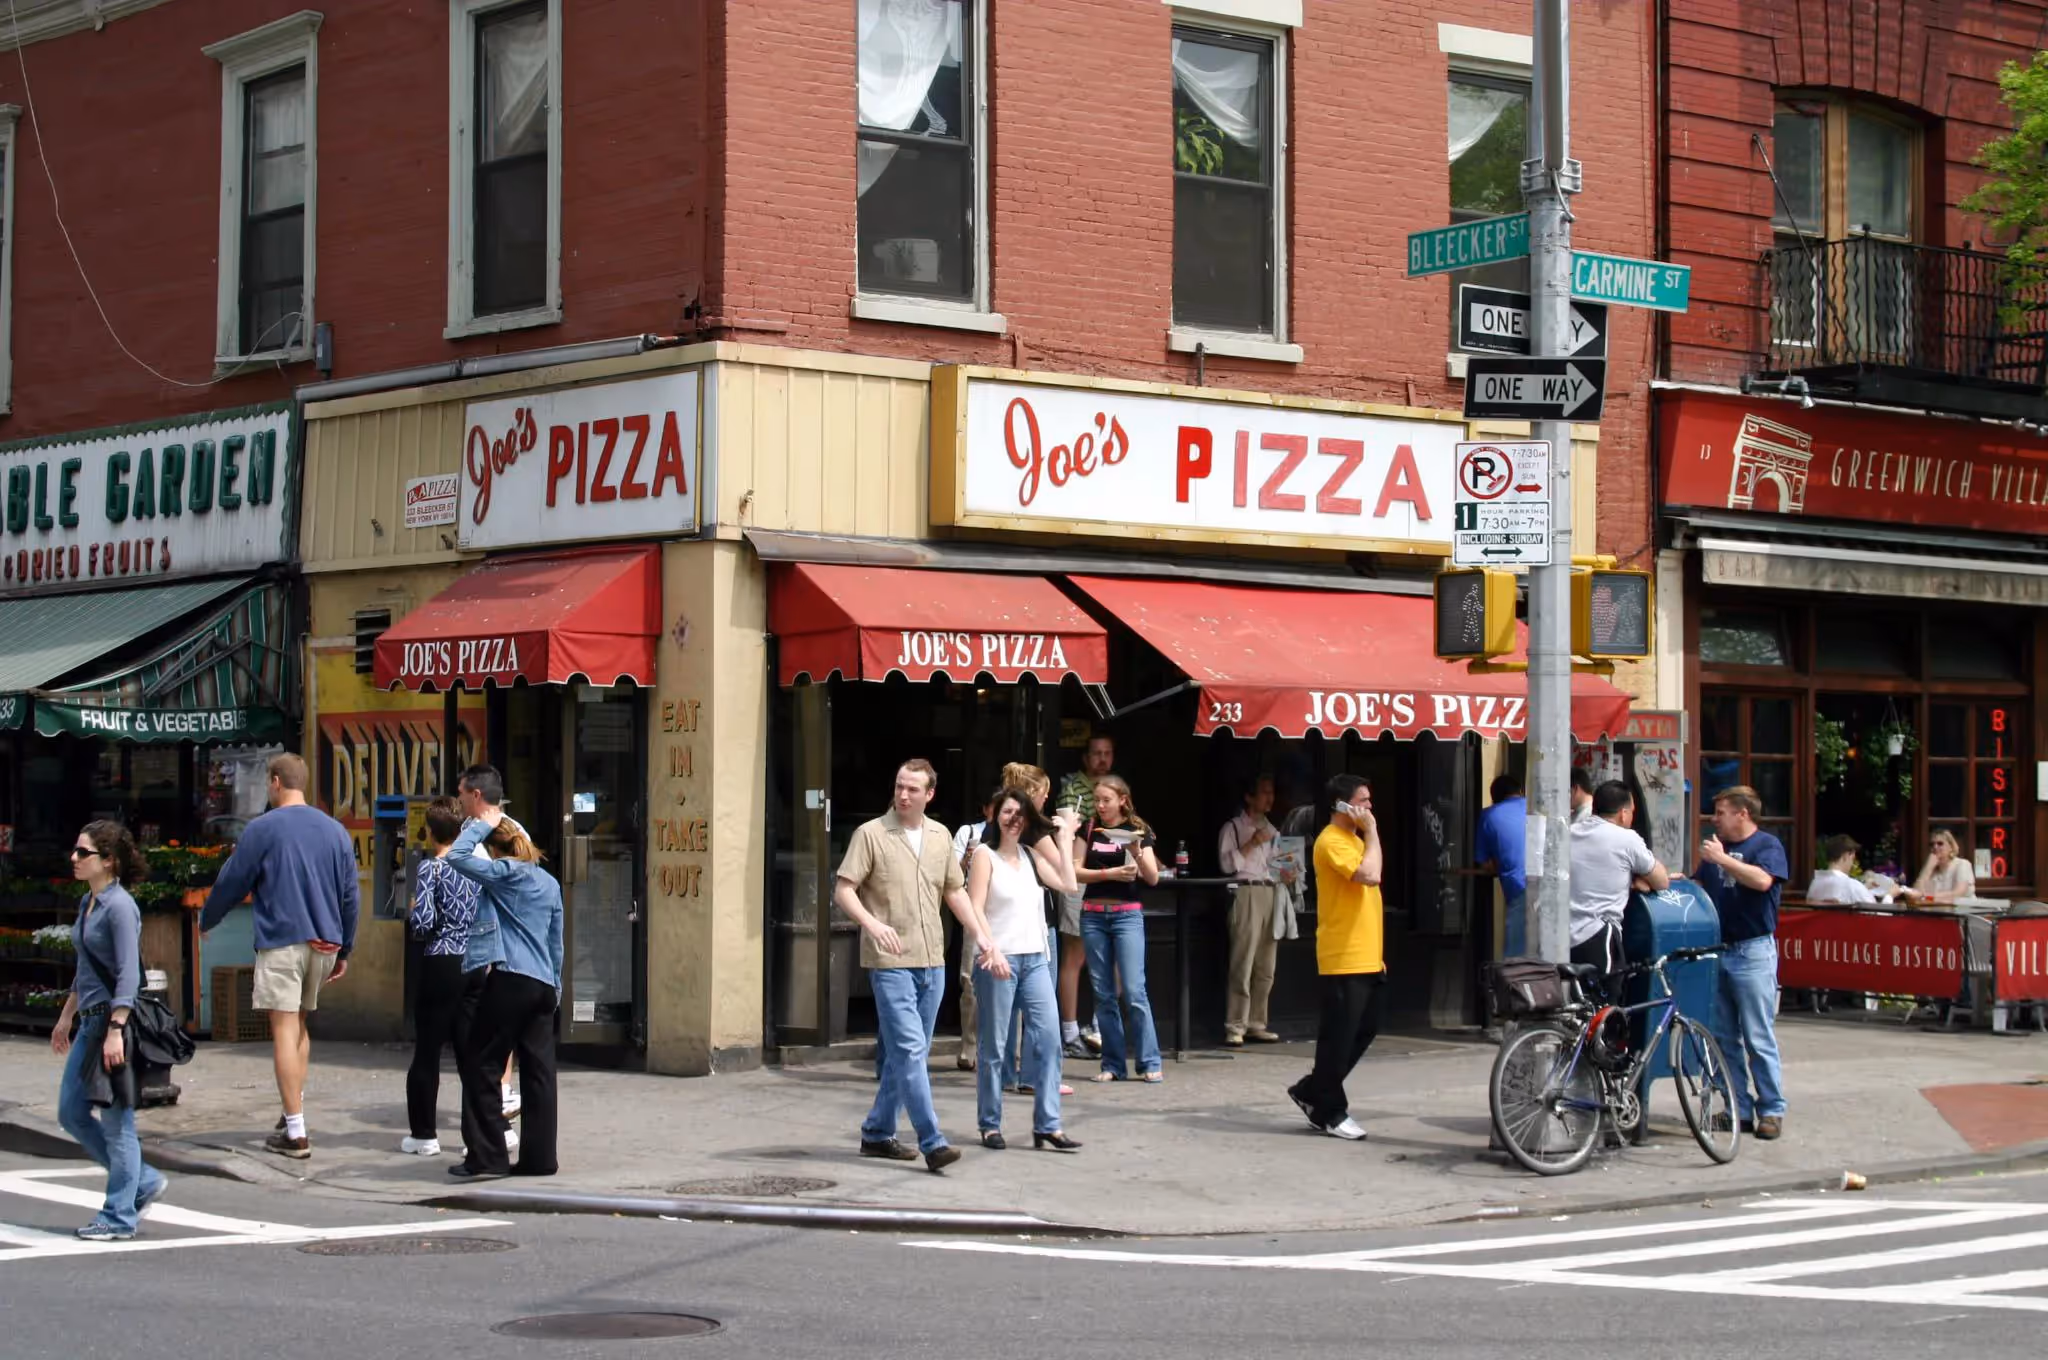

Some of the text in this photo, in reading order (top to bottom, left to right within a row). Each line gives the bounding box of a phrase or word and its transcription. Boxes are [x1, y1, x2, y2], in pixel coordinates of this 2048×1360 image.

[1411, 218, 1526, 271] BLEECKER ST
[1575, 257, 1682, 302] CARMINE ST
[1482, 308, 1522, 335] ONE
[1485, 377, 1584, 402] ONE WAY
[466, 407, 687, 526] Joe's PIZZA
[1004, 396, 1432, 521] Joe's PIZZA
[1831, 448, 1974, 499] GREENWICH
[0, 429, 276, 535] BLE GARDEN
[428, 478, 457, 497] PIZZA
[418, 514, 433, 523] YORK
[447, 502, 455, 511] ST
[1462, 504, 1469, 529] 1
[1461, 534, 1542, 544] INCLUDING SUNDAY
[1719, 554, 1757, 578] BAR
[400, 638, 519, 677] JOE'S PIZZA
[899, 631, 1067, 669] JOE'S PIZZA
[80, 709, 131, 731] FRUIT
[135, 712, 149, 732] &
[662, 700, 702, 732] EAT
[1209, 702, 1243, 723] 233
[1304, 690, 1526, 729] JOE'S PIZZ
[1626, 718, 1673, 737] ATM
[333, 738, 482, 819] DELIVEY
[669, 746, 693, 778] IN
[1991, 709, 2006, 878] BISTRO
[655, 818, 708, 853] TAKE
[660, 864, 702, 898] OUT
[1814, 939, 1881, 966] VILLAGE
[1893, 945, 1956, 971] BISTRO
[2005, 941, 2048, 977] VIL
